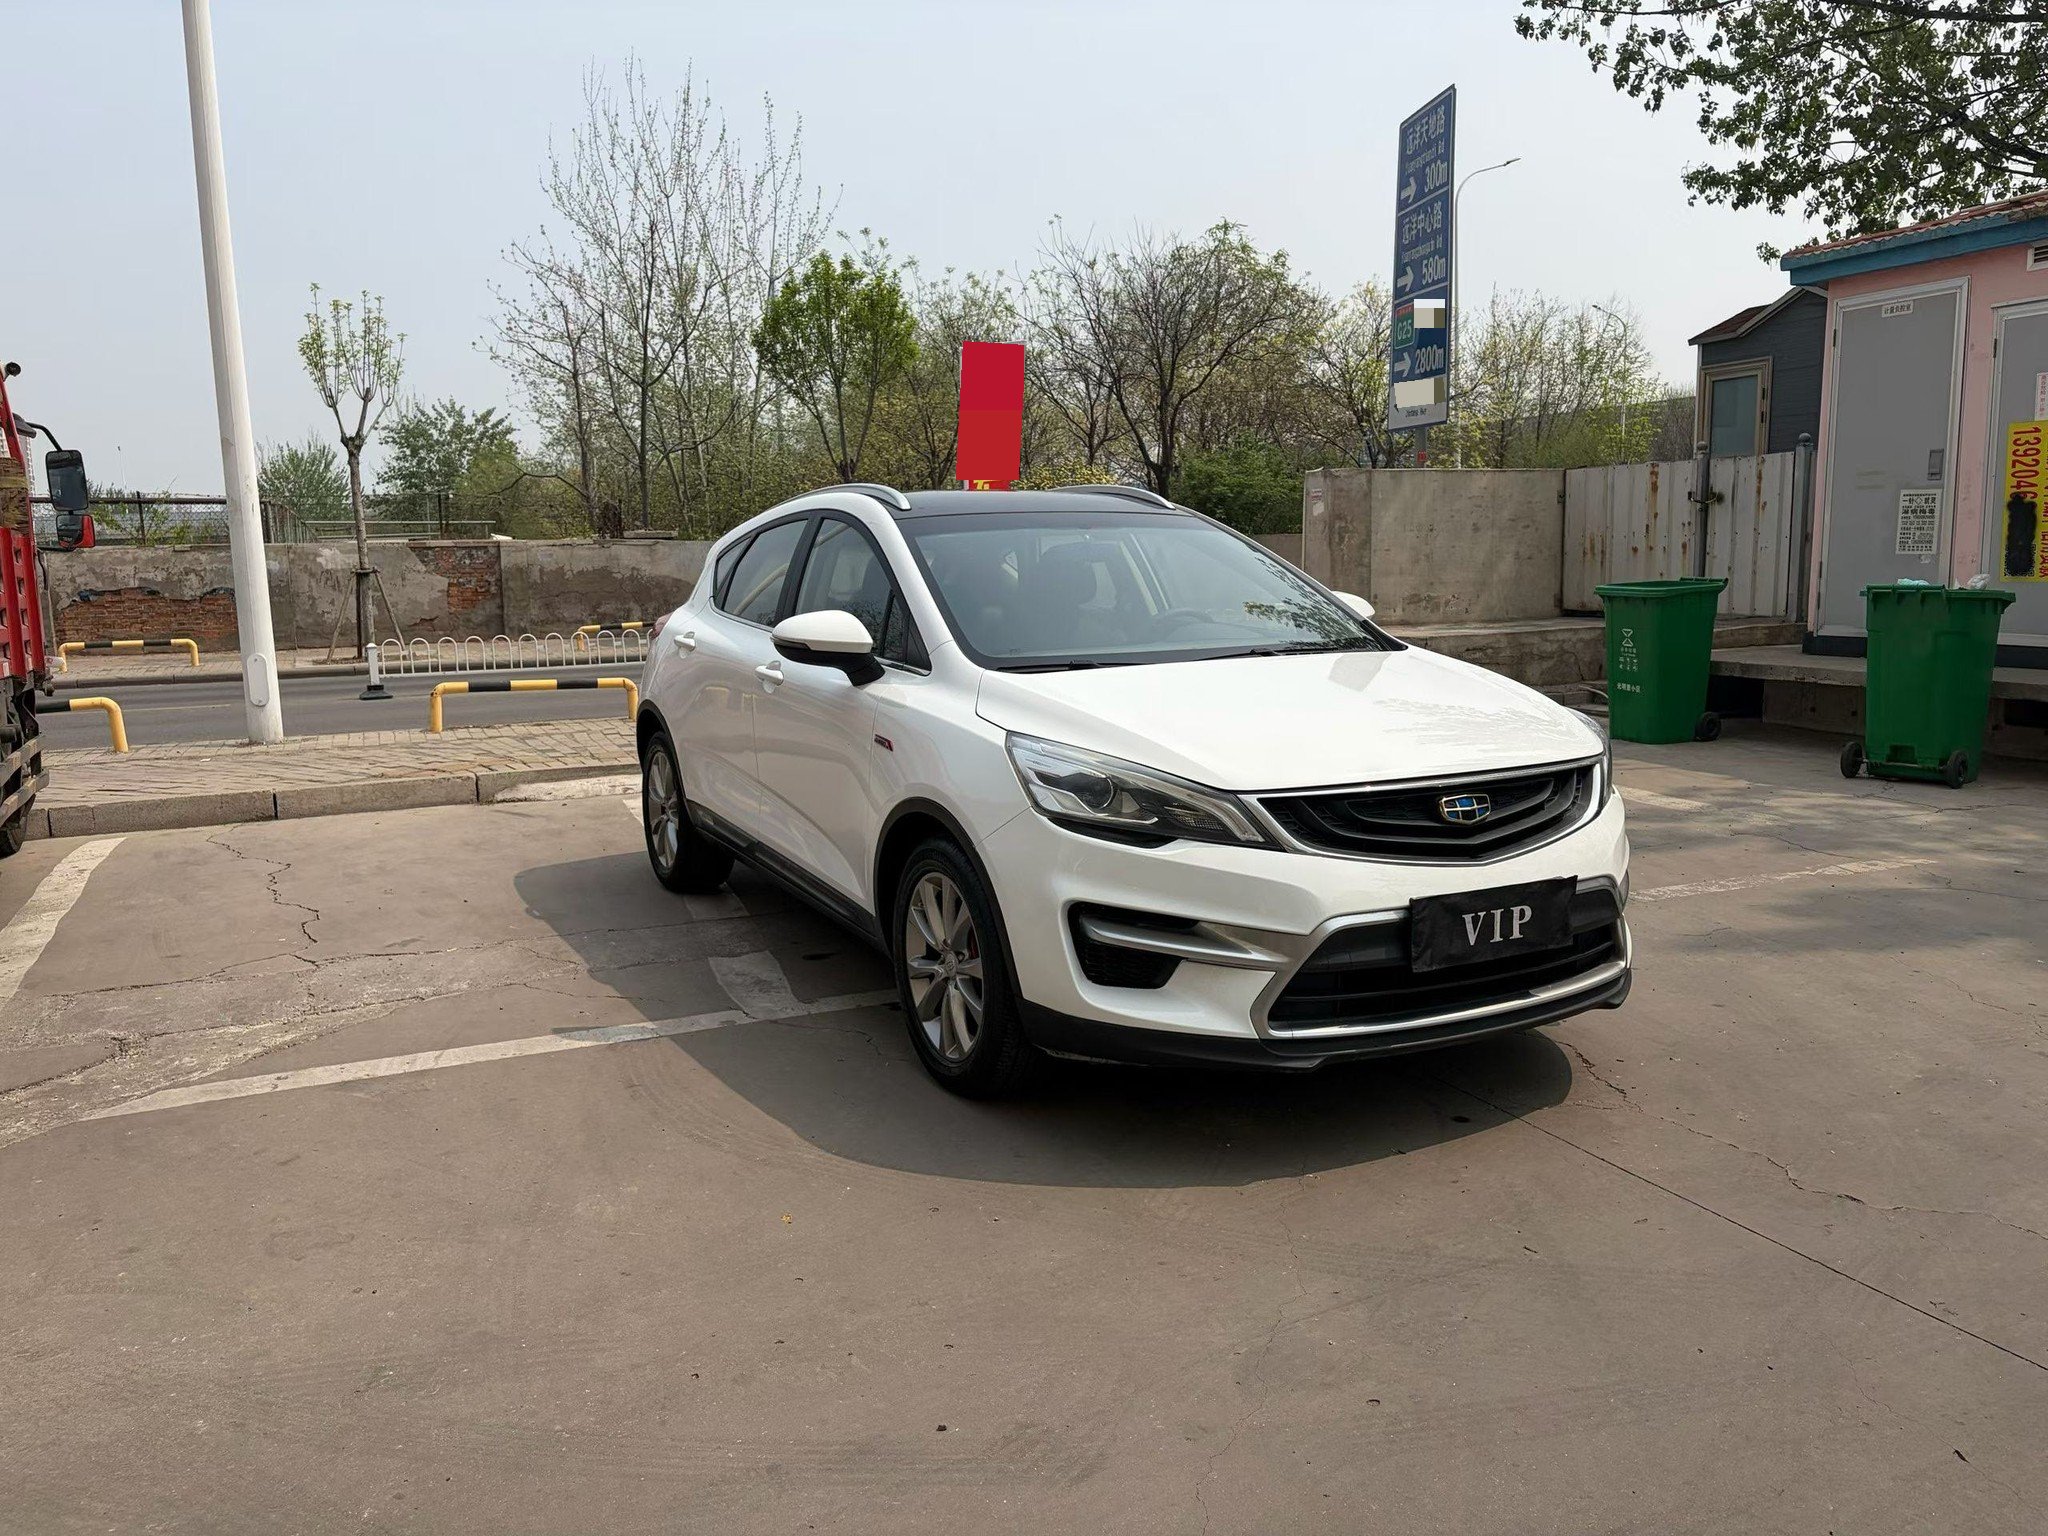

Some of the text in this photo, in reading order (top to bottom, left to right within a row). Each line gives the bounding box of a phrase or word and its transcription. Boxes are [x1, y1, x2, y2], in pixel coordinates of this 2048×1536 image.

[1406, 104, 1445, 155] 远洋天地路
[1424, 159, 1448, 193] 300m
[1402, 200, 1442, 245] 远洋中心路
[1422, 255, 1446, 285] 580m
[1396, 318, 1412, 341] G25
[1415, 344, 1444, 375] 2800m
[1462, 905, 1532, 946] VIP
